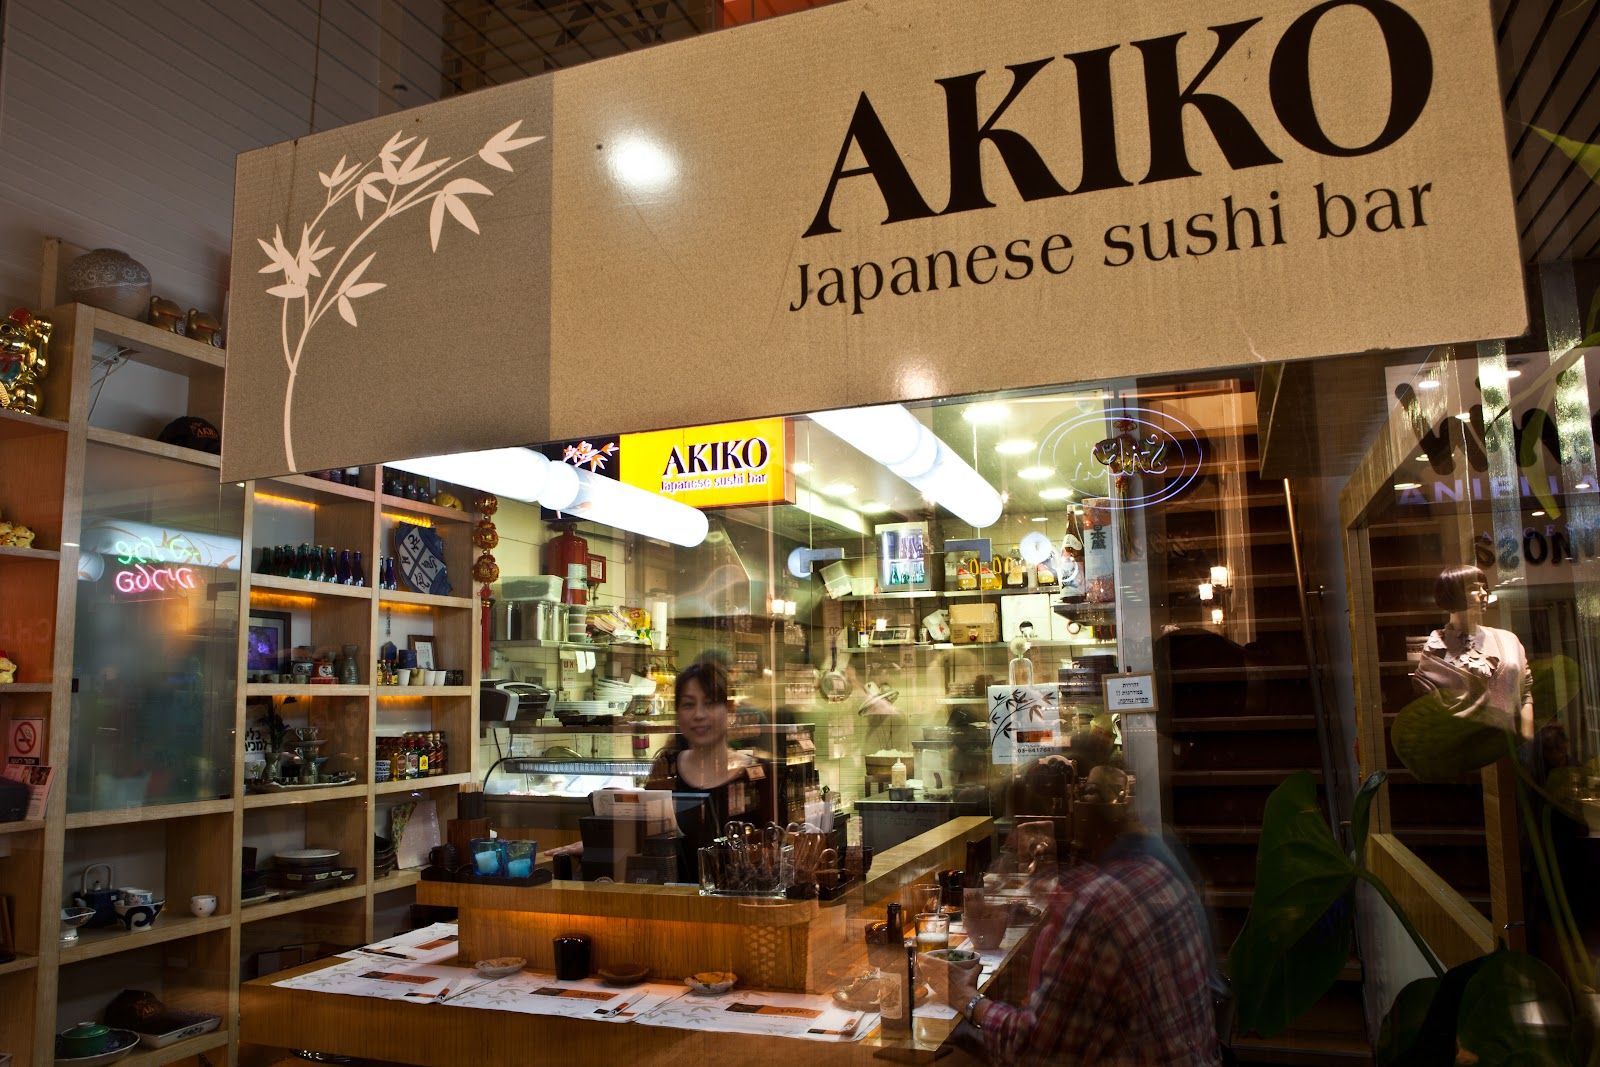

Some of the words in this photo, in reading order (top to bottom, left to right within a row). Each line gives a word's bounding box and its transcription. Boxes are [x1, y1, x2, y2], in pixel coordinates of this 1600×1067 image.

[801, 0, 1434, 238] AKIKO
[789, 232, 1075, 316] Japanese
[1103, 190, 1287, 269] sushi
[1314, 180, 1433, 242] bar
[662, 438, 768, 475] AKIKO
[714, 474, 743, 486] sushi
[748, 472, 765, 483] bar
